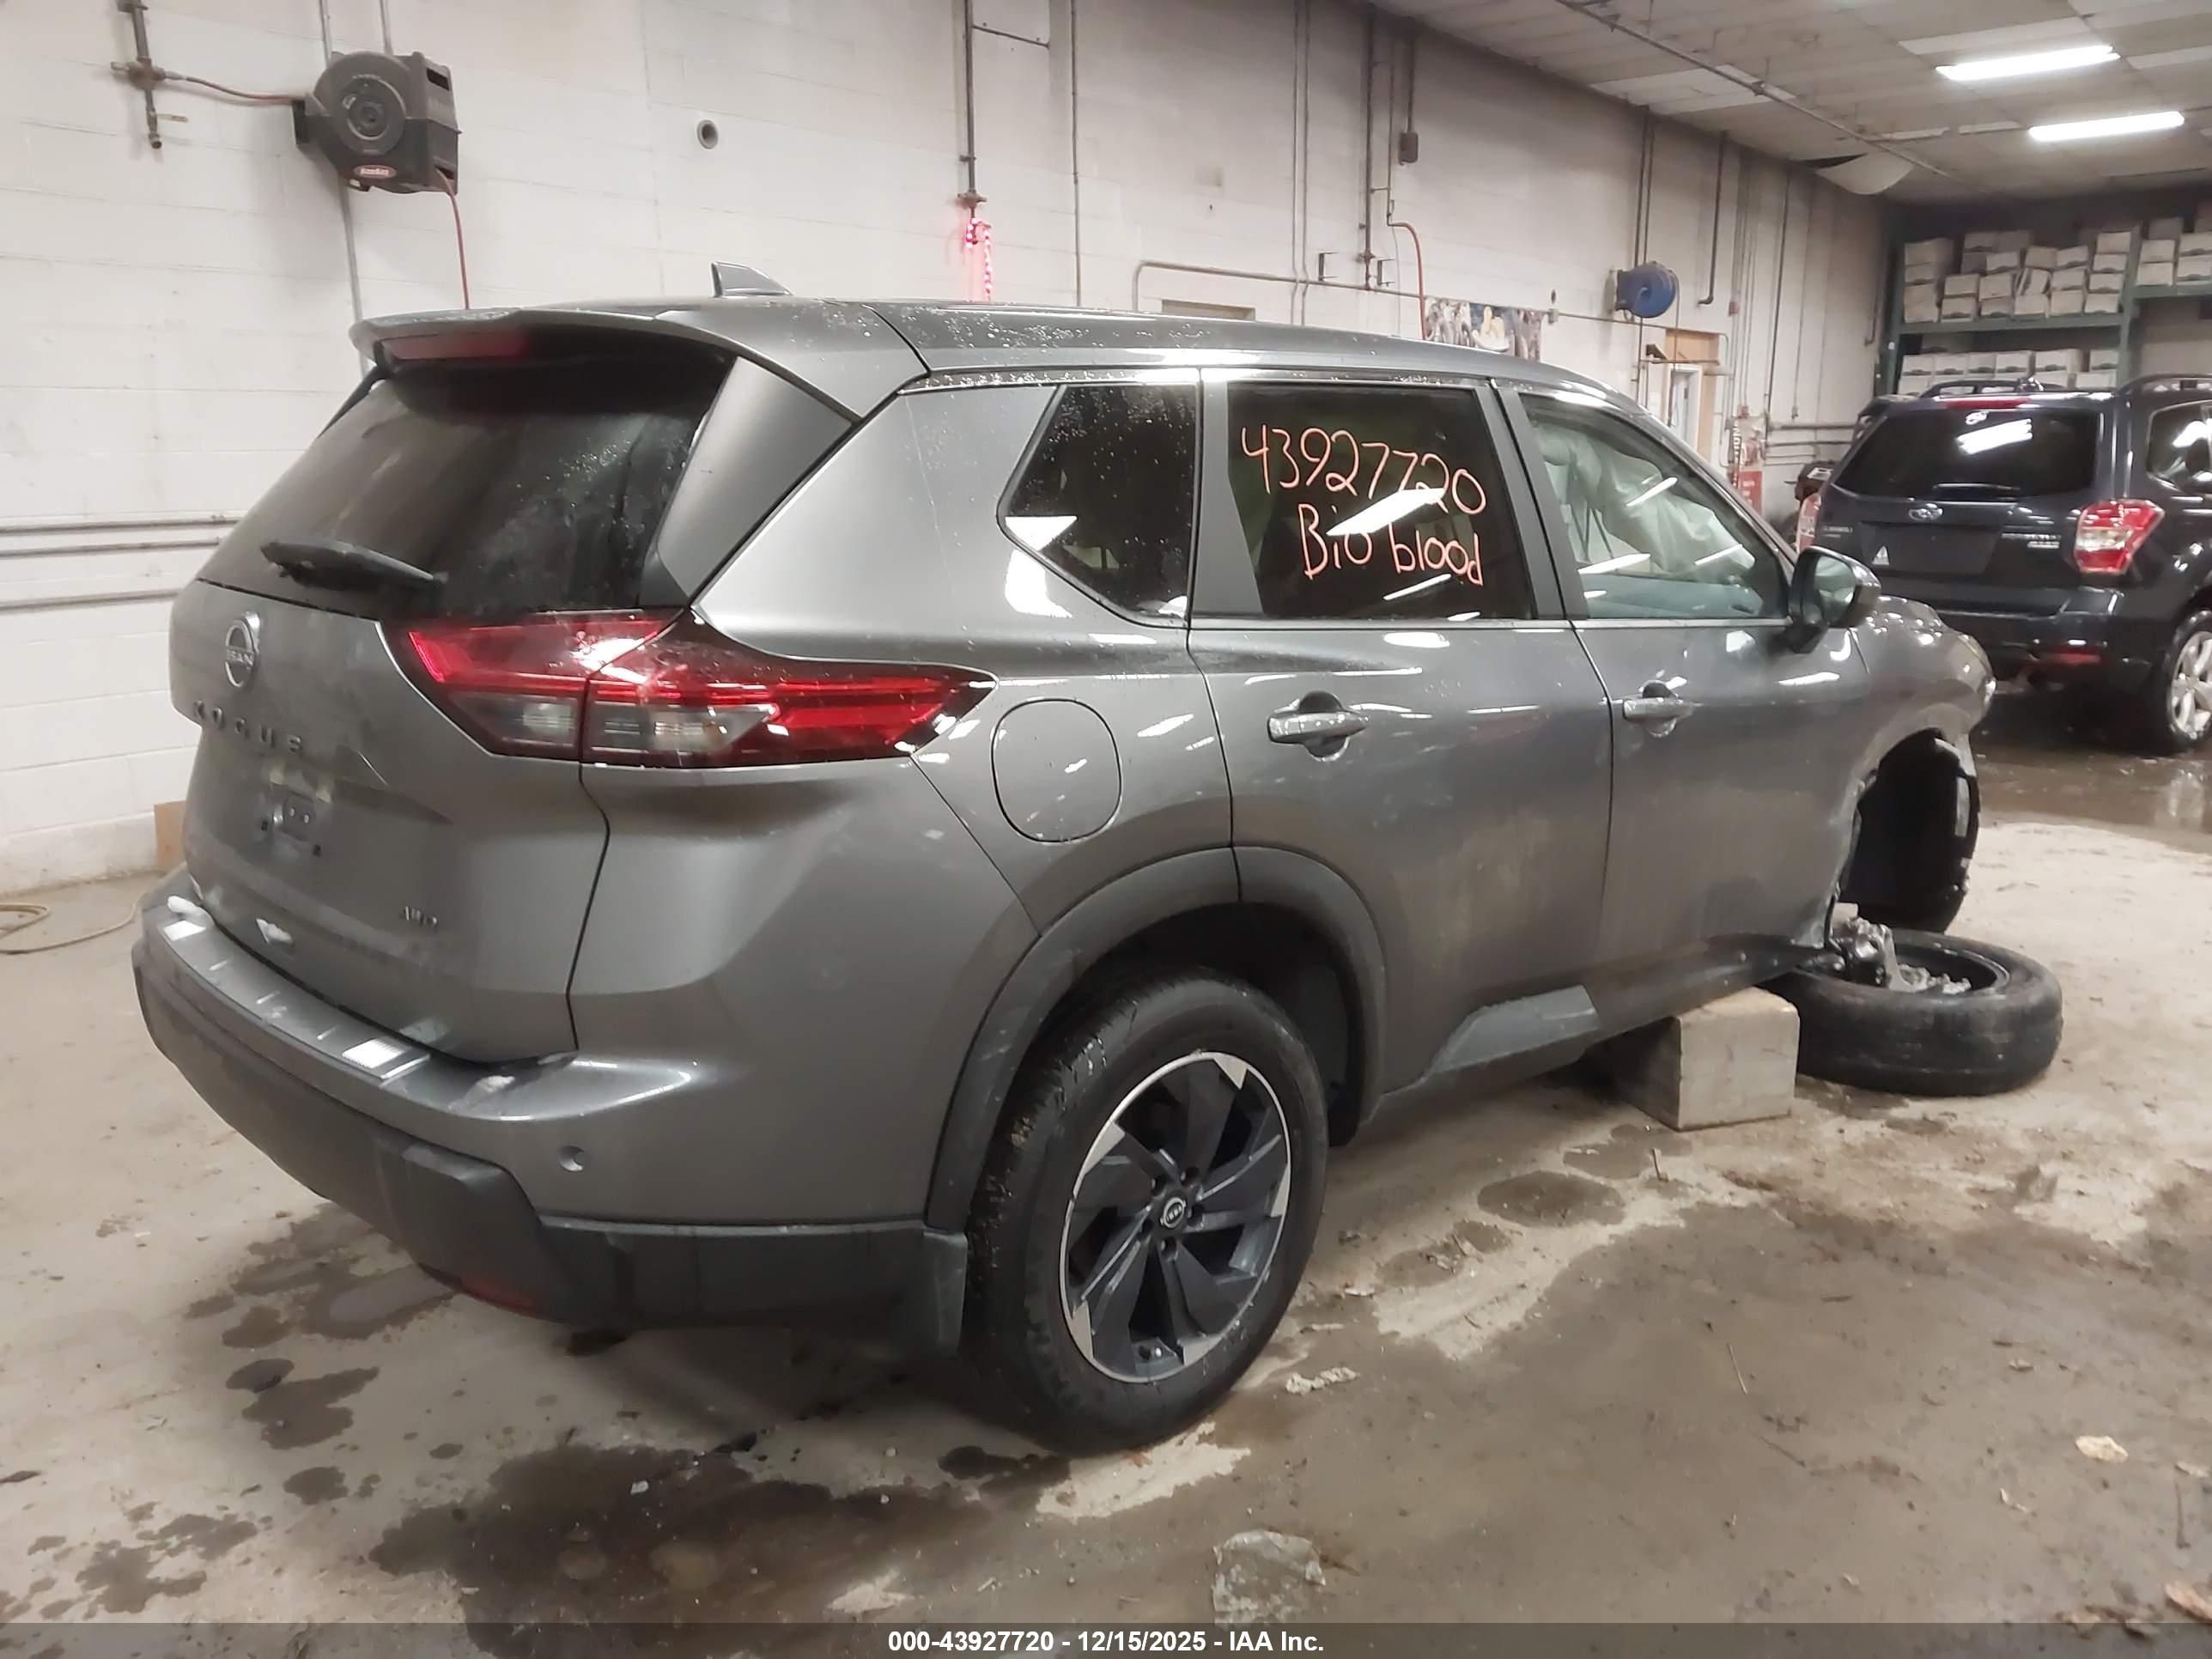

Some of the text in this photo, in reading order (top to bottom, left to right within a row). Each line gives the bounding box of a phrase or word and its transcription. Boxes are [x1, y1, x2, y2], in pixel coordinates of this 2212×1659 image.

[1242, 424, 1486, 514] 43927720
[1298, 503, 1484, 586] Bio blood
